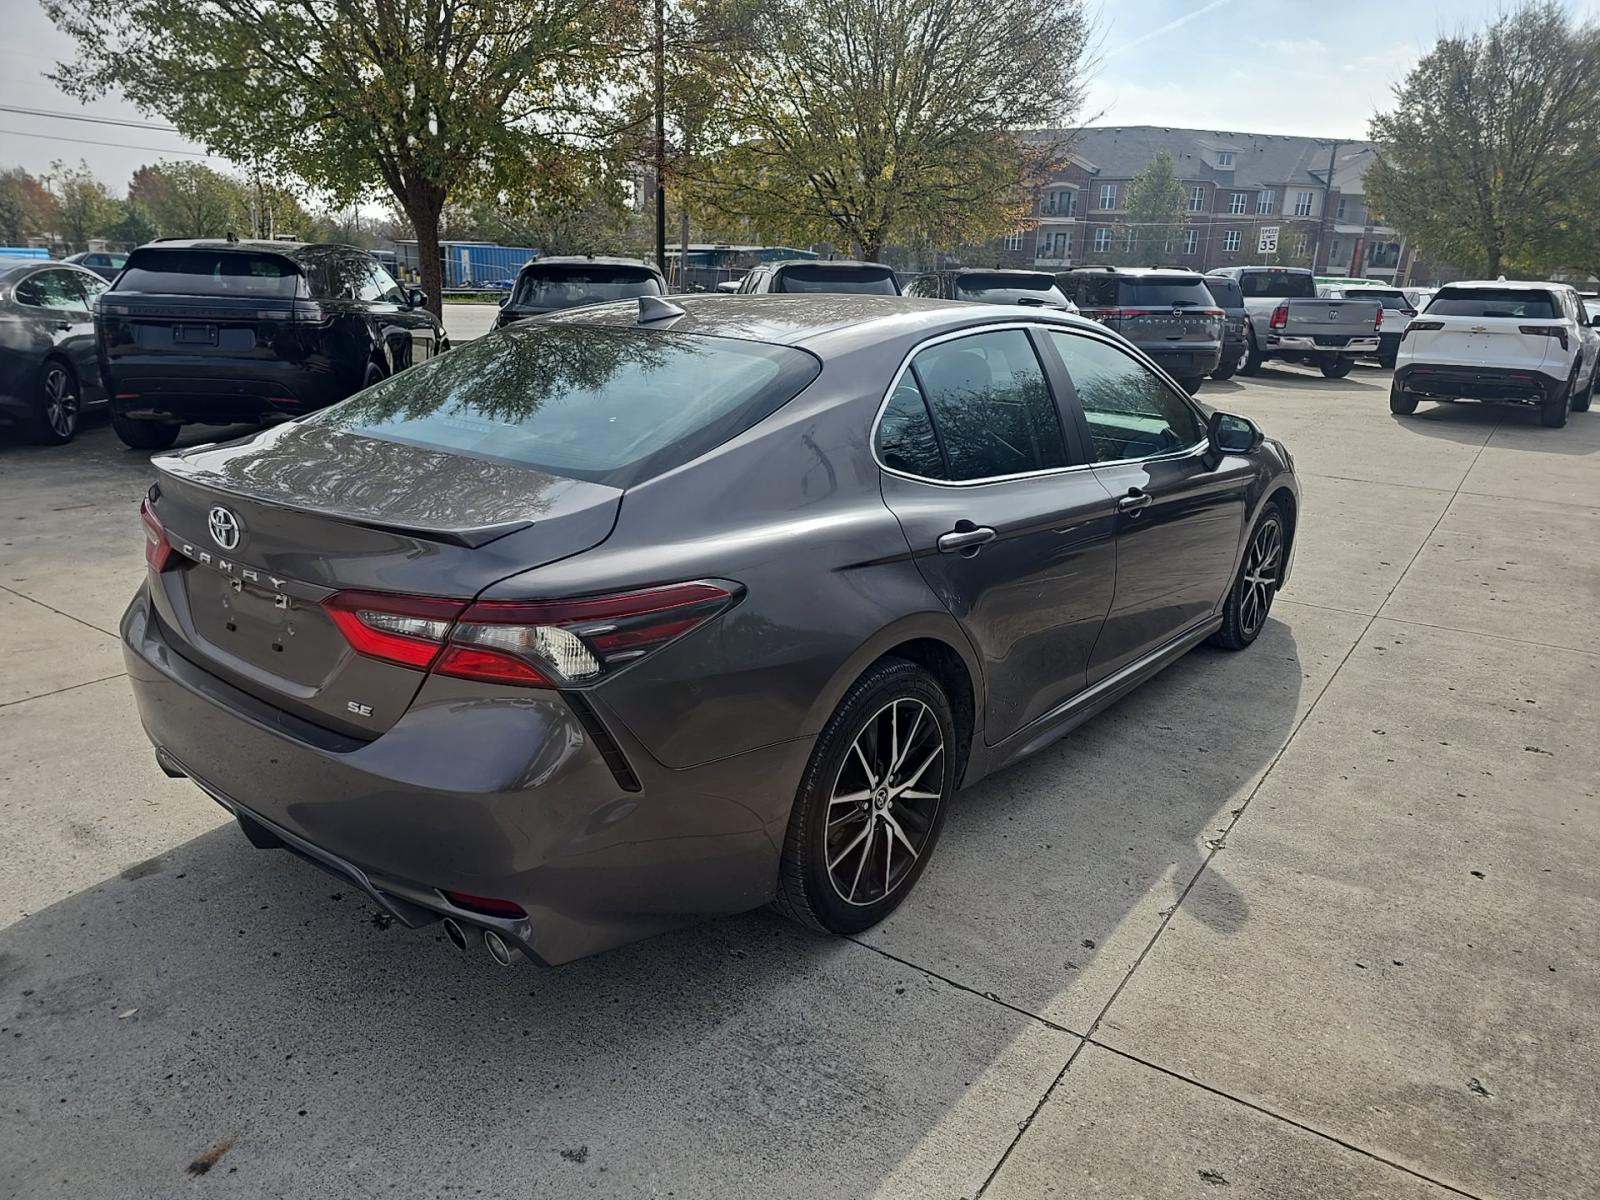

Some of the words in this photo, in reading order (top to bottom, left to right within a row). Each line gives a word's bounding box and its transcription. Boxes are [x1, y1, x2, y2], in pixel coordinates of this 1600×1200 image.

[1260, 240, 1276, 250] 35
[183, 544, 287, 589] CAMRY
[347, 701, 374, 717] SE
